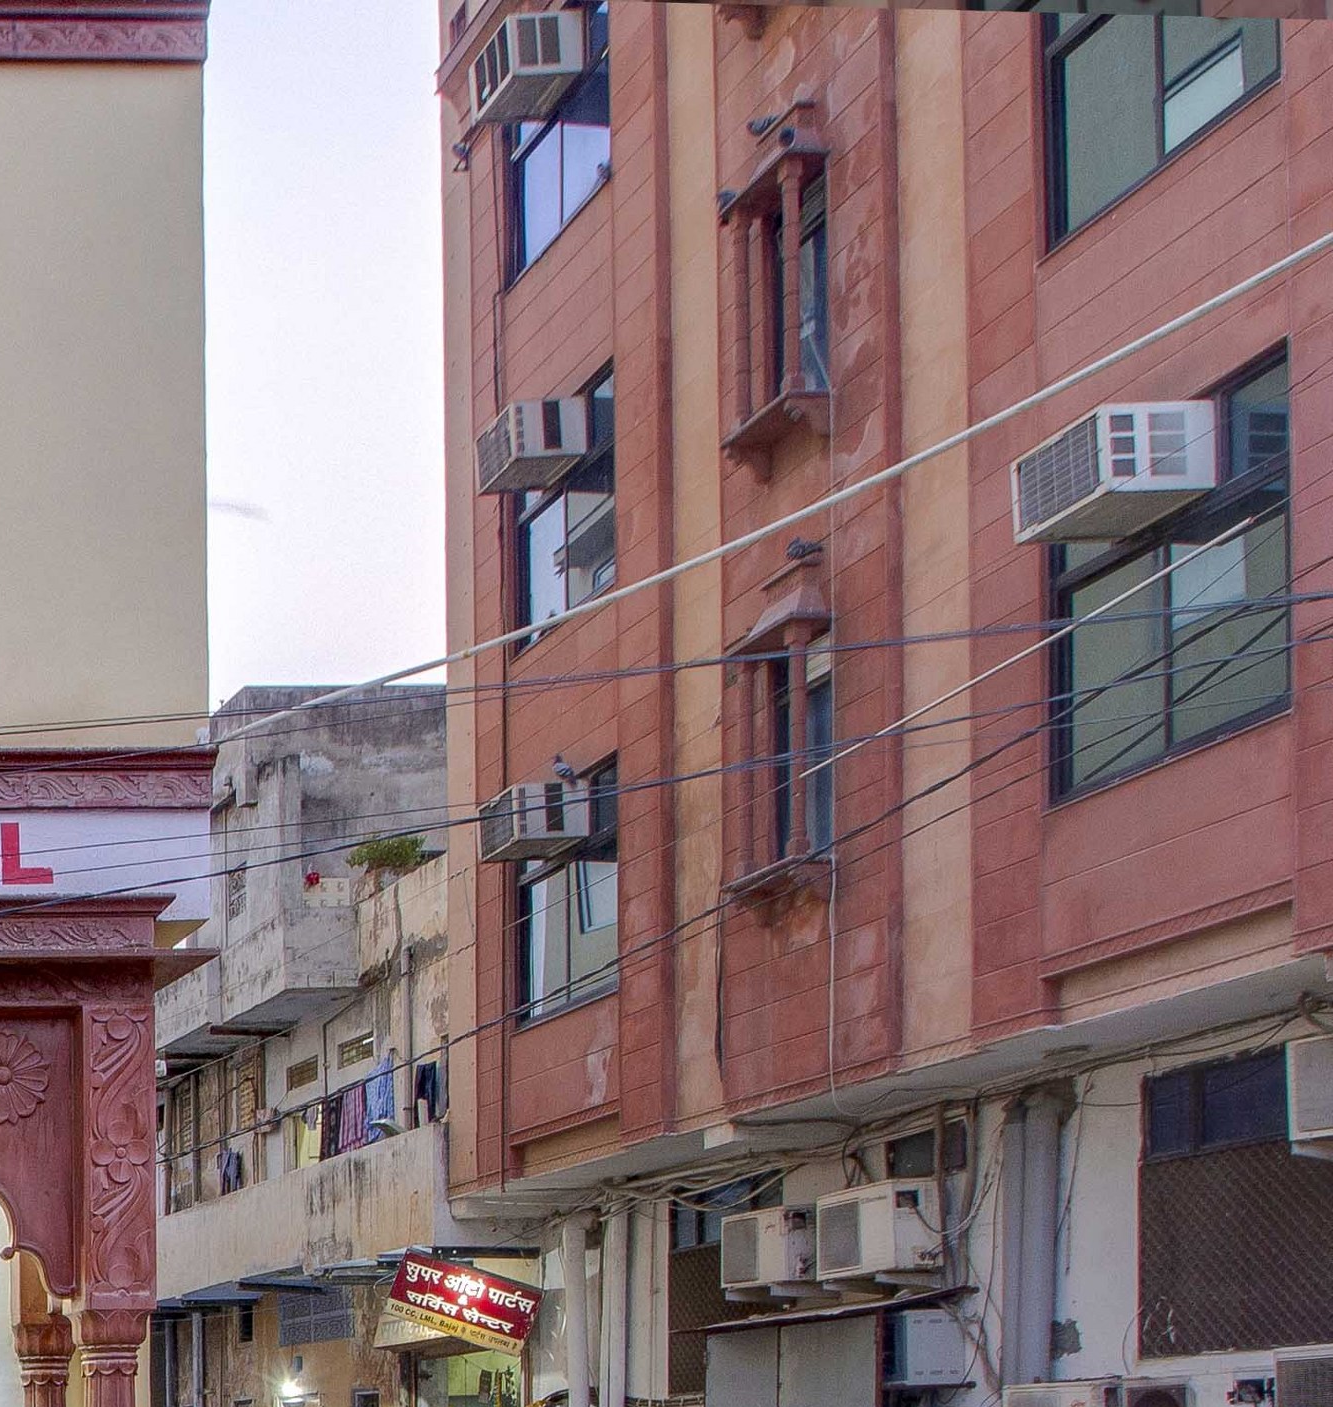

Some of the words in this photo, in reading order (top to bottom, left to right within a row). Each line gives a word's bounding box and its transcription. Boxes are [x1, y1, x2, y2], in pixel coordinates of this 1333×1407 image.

[406, 1261, 444, 1285] सुपर
[488, 1288, 535, 1314] पार्टस
[406, 1290, 460, 1317] सर्विस
[462, 1307, 515, 1334] सेन्टर
